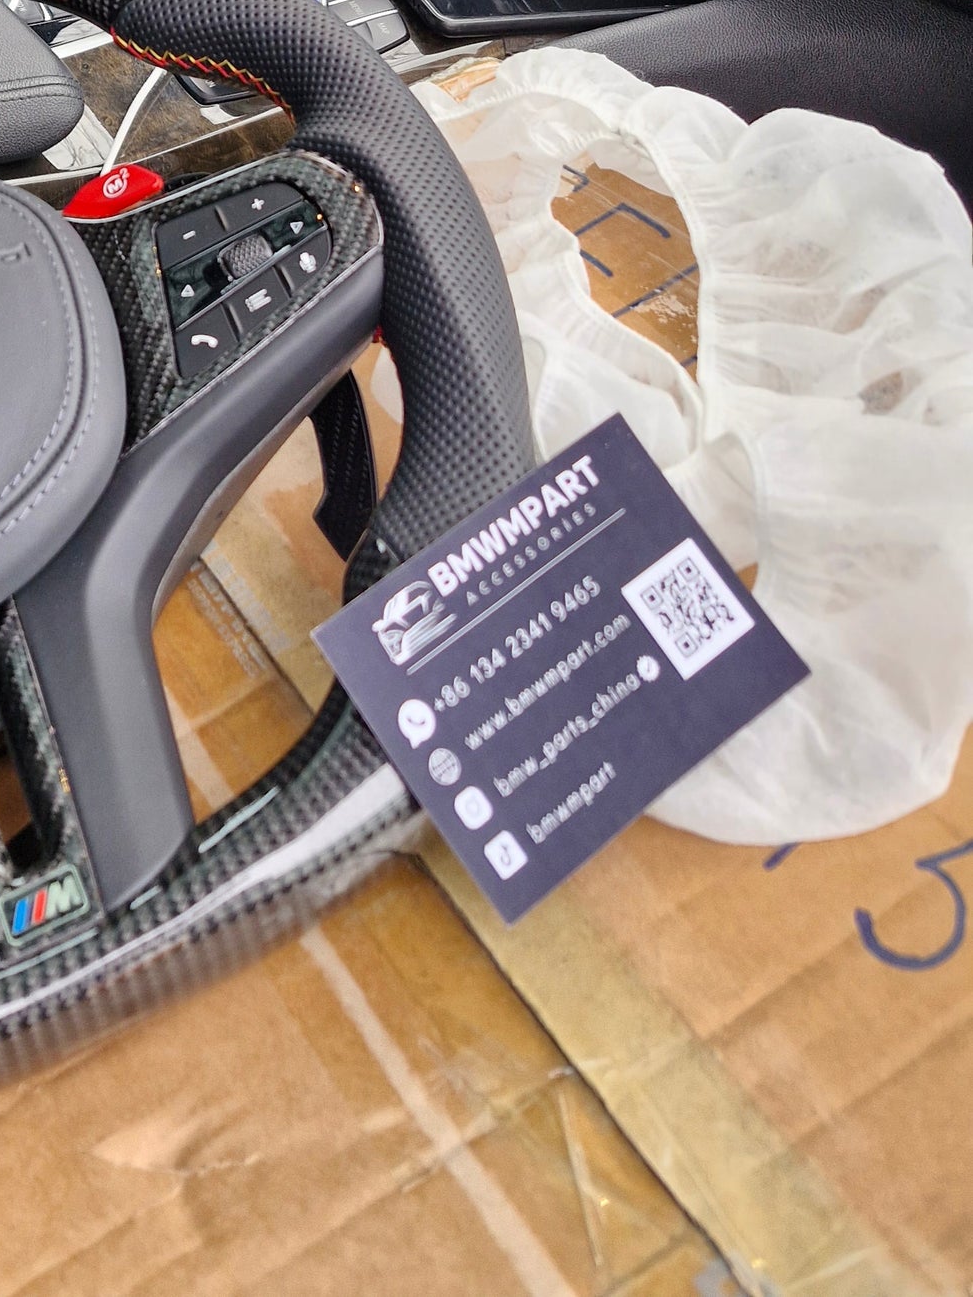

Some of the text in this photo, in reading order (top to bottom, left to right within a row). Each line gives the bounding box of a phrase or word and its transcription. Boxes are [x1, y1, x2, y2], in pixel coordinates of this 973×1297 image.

[428, 455, 600, 597] BMWMPART
[466, 503, 597, 606] ACCESSORIES
[434, 575, 601, 712] +86 134 2341 9465
[464, 614, 631, 751] www.bmwmpart.com
[493, 673, 641, 798] bmw_parts_china
[526, 761, 617, 844] bmwmpart
